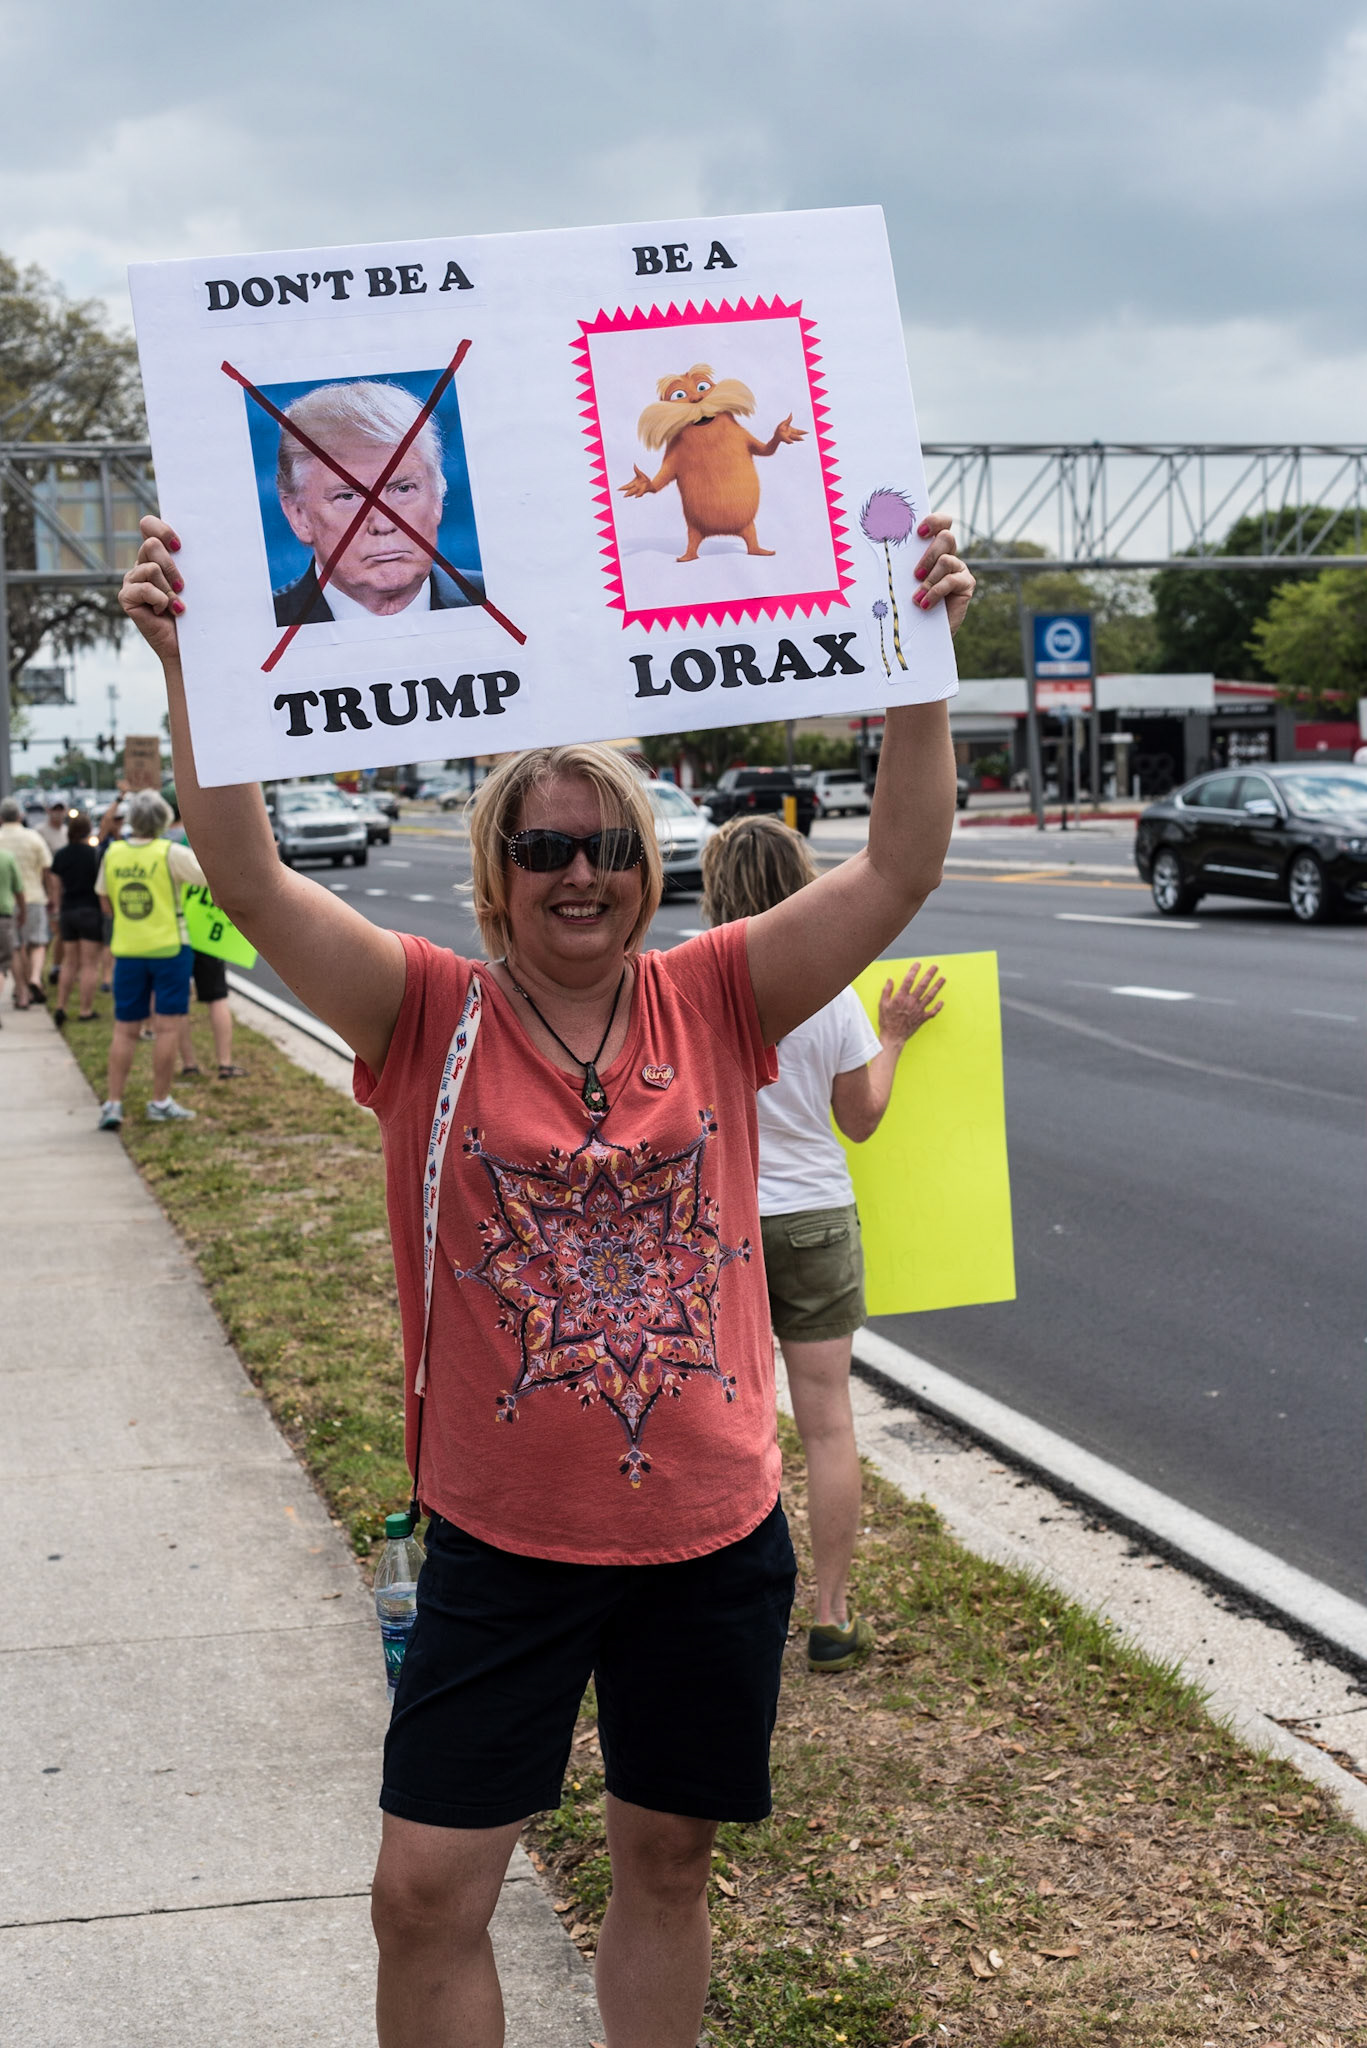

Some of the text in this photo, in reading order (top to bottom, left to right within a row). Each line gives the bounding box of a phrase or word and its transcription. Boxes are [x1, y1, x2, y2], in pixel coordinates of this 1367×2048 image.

[631, 240, 738, 276] BE A
[204, 260, 475, 311] DON'T BE A
[628, 631, 866, 698] LORAX
[273, 670, 521, 737] TRUMP
[451, 1056, 467, 1080] Disney
